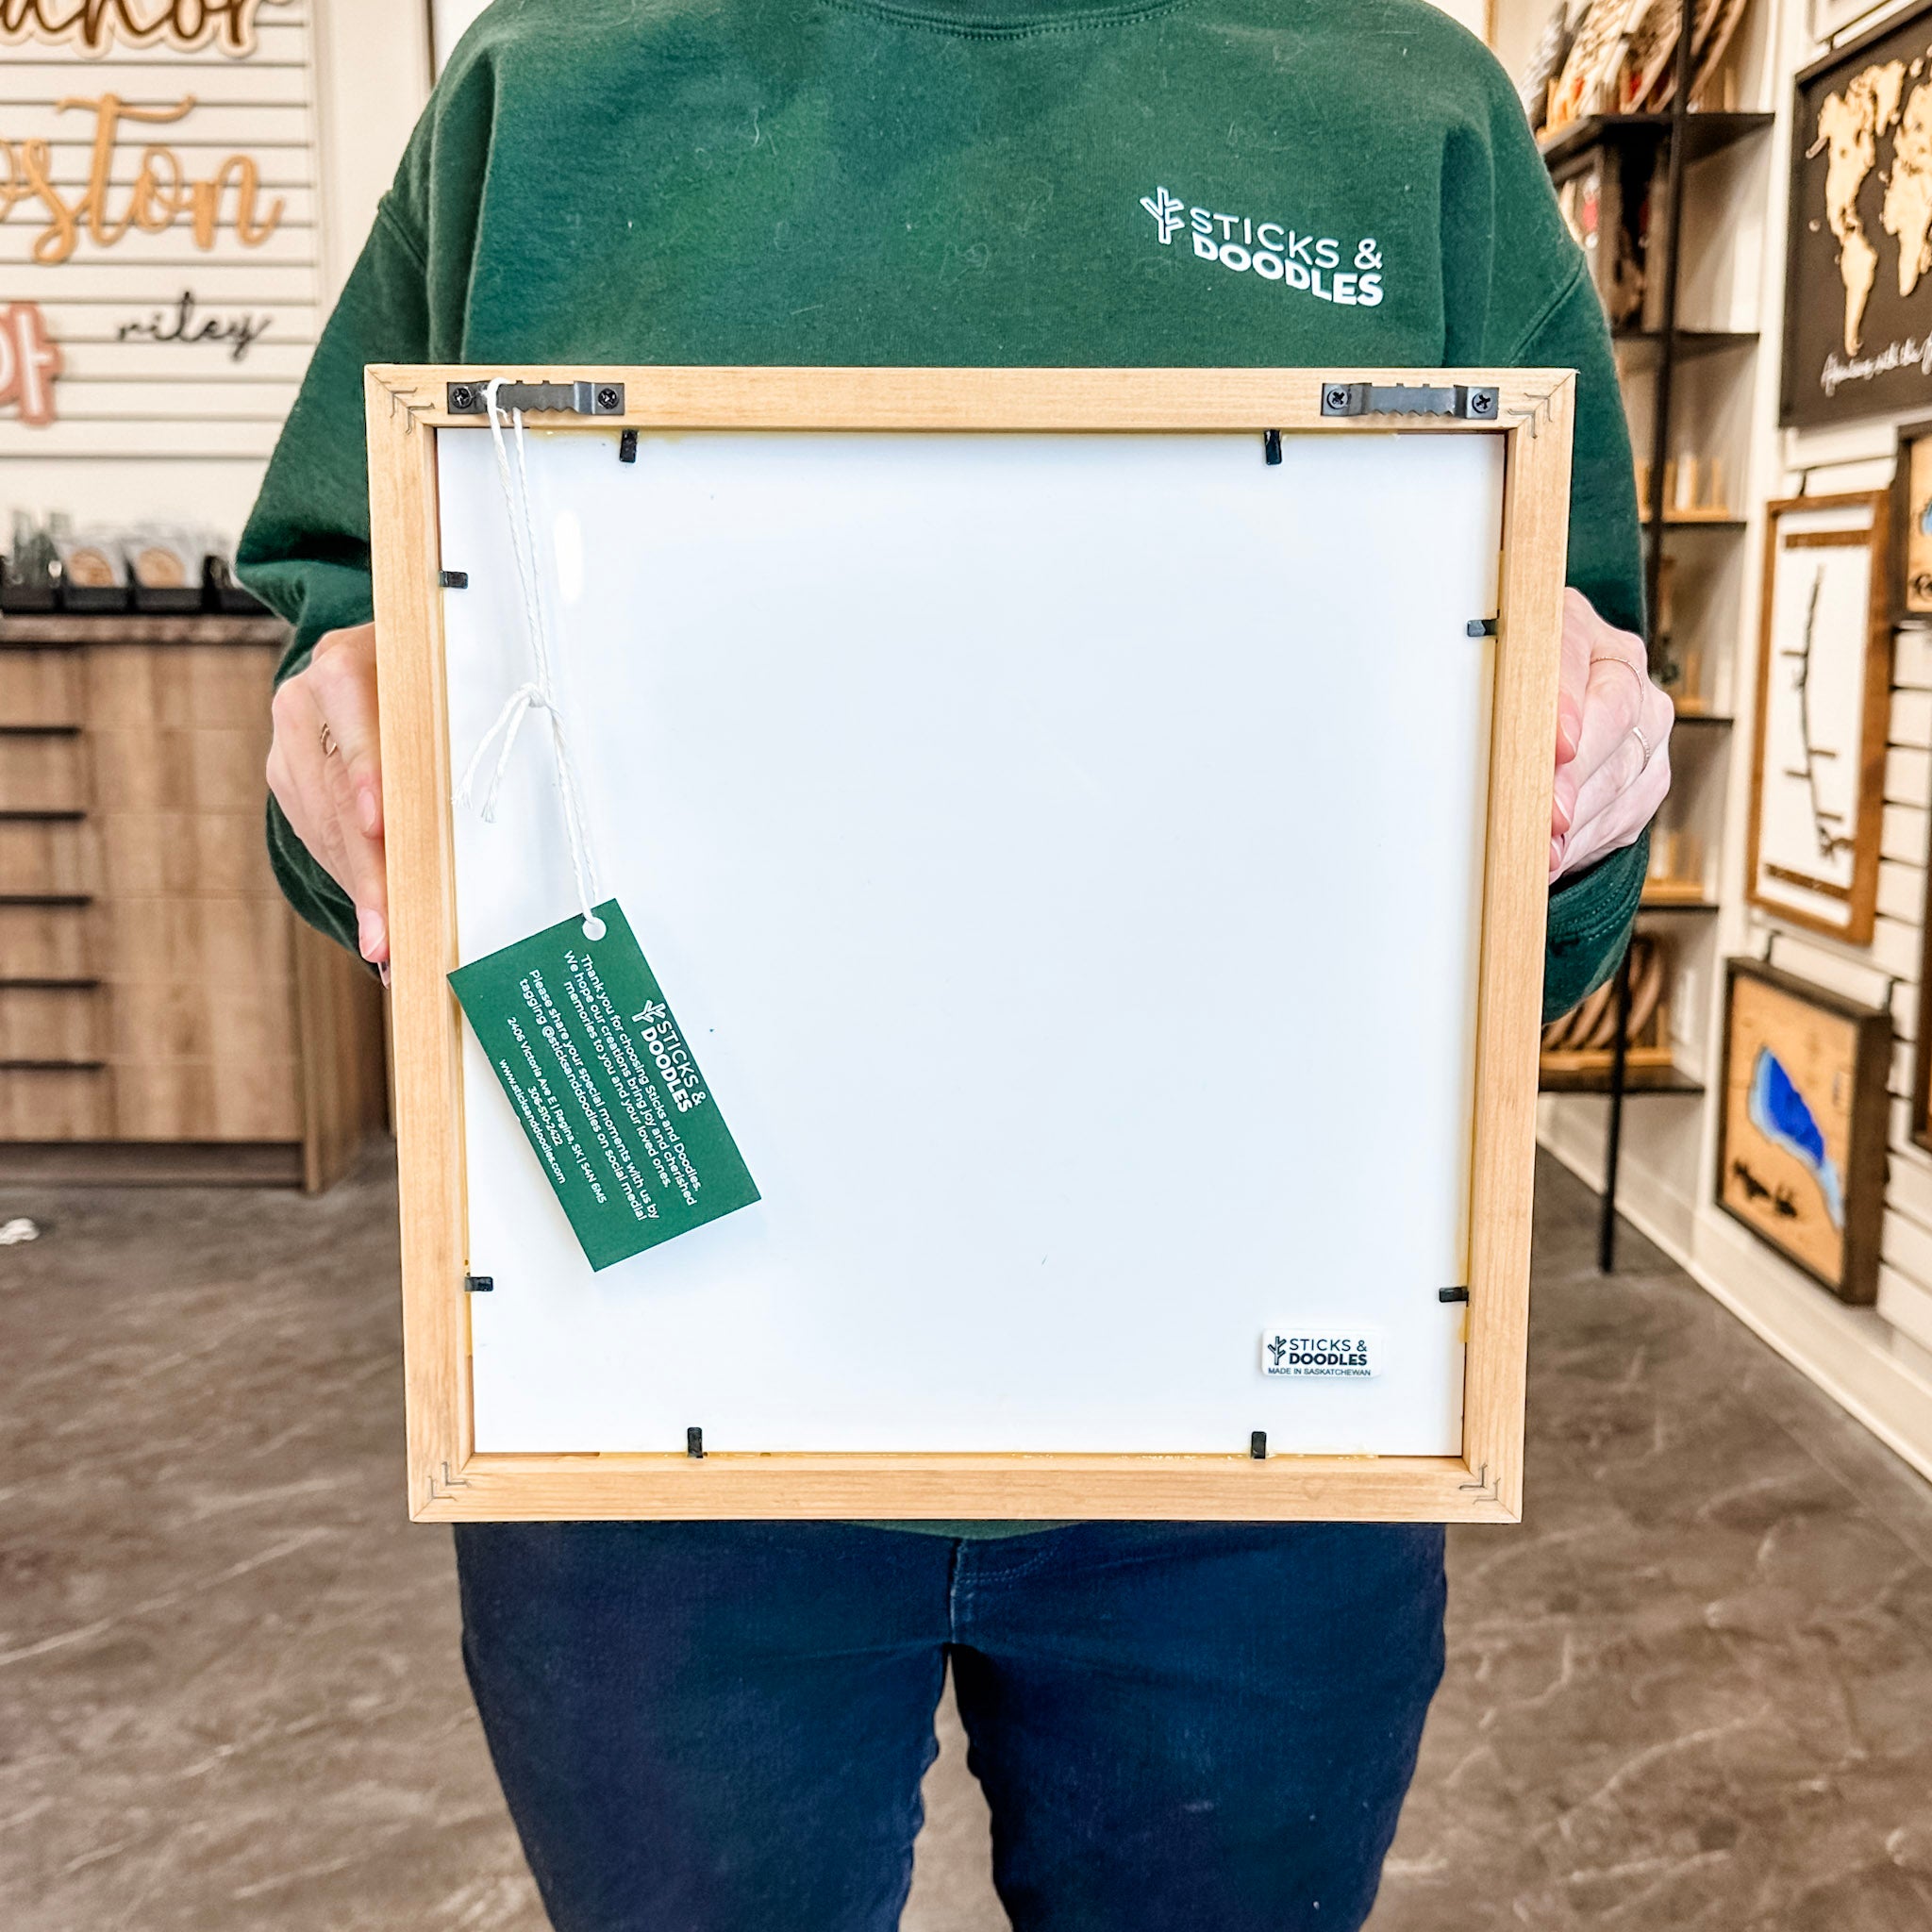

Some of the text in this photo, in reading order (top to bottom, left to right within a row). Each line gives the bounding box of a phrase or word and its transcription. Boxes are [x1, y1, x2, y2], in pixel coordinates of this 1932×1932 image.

[1190, 207, 1383, 270] STICKS &
[1191, 231, 1384, 307] DOODLES
[519, 978, 547, 1024] tagging
[541, 1025, 601, 1132] @sticksanddoodles
[596, 1132, 609, 1149] on
[605, 1149, 628, 1181] social
[528, 969, 659, 1218] Please share your special moments with us by
[563, 950, 697, 1206] We hope our creations bring joy and cherished
[563, 980, 671, 1188] memories to you and your loved ones.
[580, 954, 701, 1191] Thank you for choosing Sticks and Doodles.
[641, 1025, 692, 1112] DOODLES
[656, 1020, 706, 1106] STICKS &
[499, 1058, 565, 1184] www.sticksanddoodles.com
[507, 1016, 525, 1041] 2406
[520, 1040, 541, 1077] Victoria
[537, 1078, 551, 1095] Ave
[547, 1095, 558, 1105] E
[553, 1108, 575, 1144] Regina,
[571, 1143, 584, 1158] SK
[580, 1161, 597, 1183] S4N
[591, 1182, 607, 1203] 6M5
[527, 1085, 563, 1146] 306-510-2422
[1289, 1339, 1367, 1352] STICKS &
[1289, 1353, 1368, 1366] DOODLES
[1304, 1368, 1371, 1376] SASKATCHEWAN
